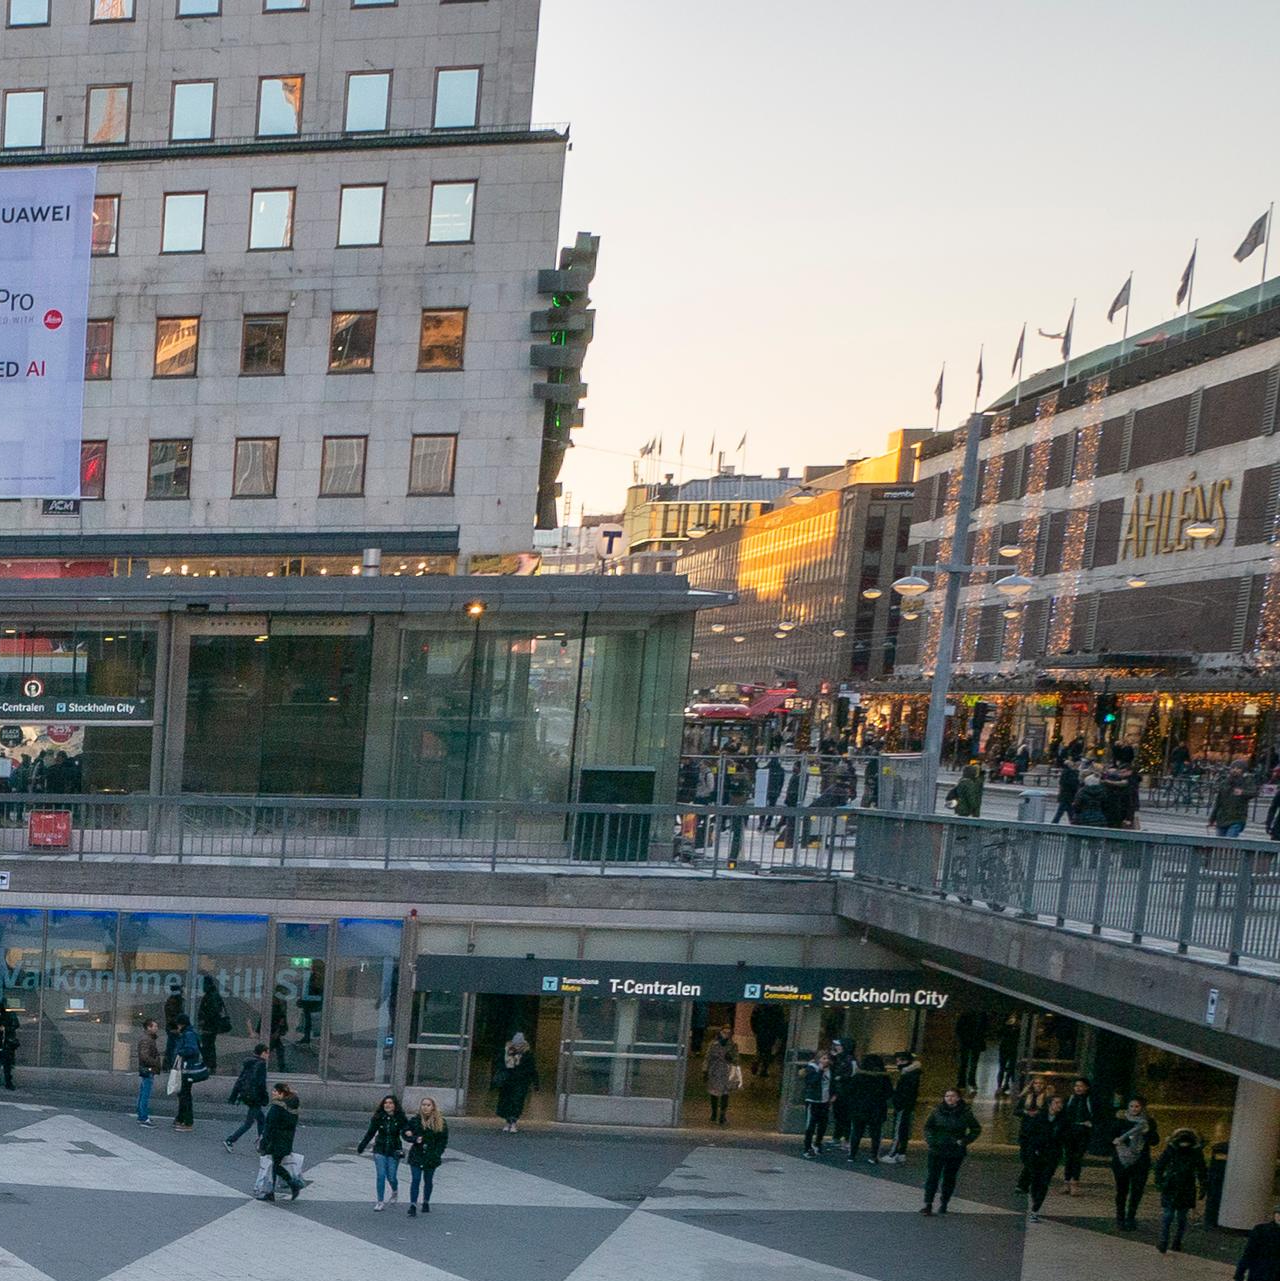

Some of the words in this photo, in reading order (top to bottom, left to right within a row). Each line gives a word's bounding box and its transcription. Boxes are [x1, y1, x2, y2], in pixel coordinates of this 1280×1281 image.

[12, 316, 35, 325] WITH
[26, 360, 46, 378] AI
[1120, 470, 1233, 561] ÅHLÉNS
[602, 530, 622, 555] T
[68, 702, 115, 713] Stockholm
[116, 702, 136, 715] City
[218, 966, 262, 999] till
[274, 968, 324, 1002] SL
[609, 978, 702, 997] T-Centralen
[822, 986, 912, 1005] Stockholm
[913, 989, 950, 1009] City
